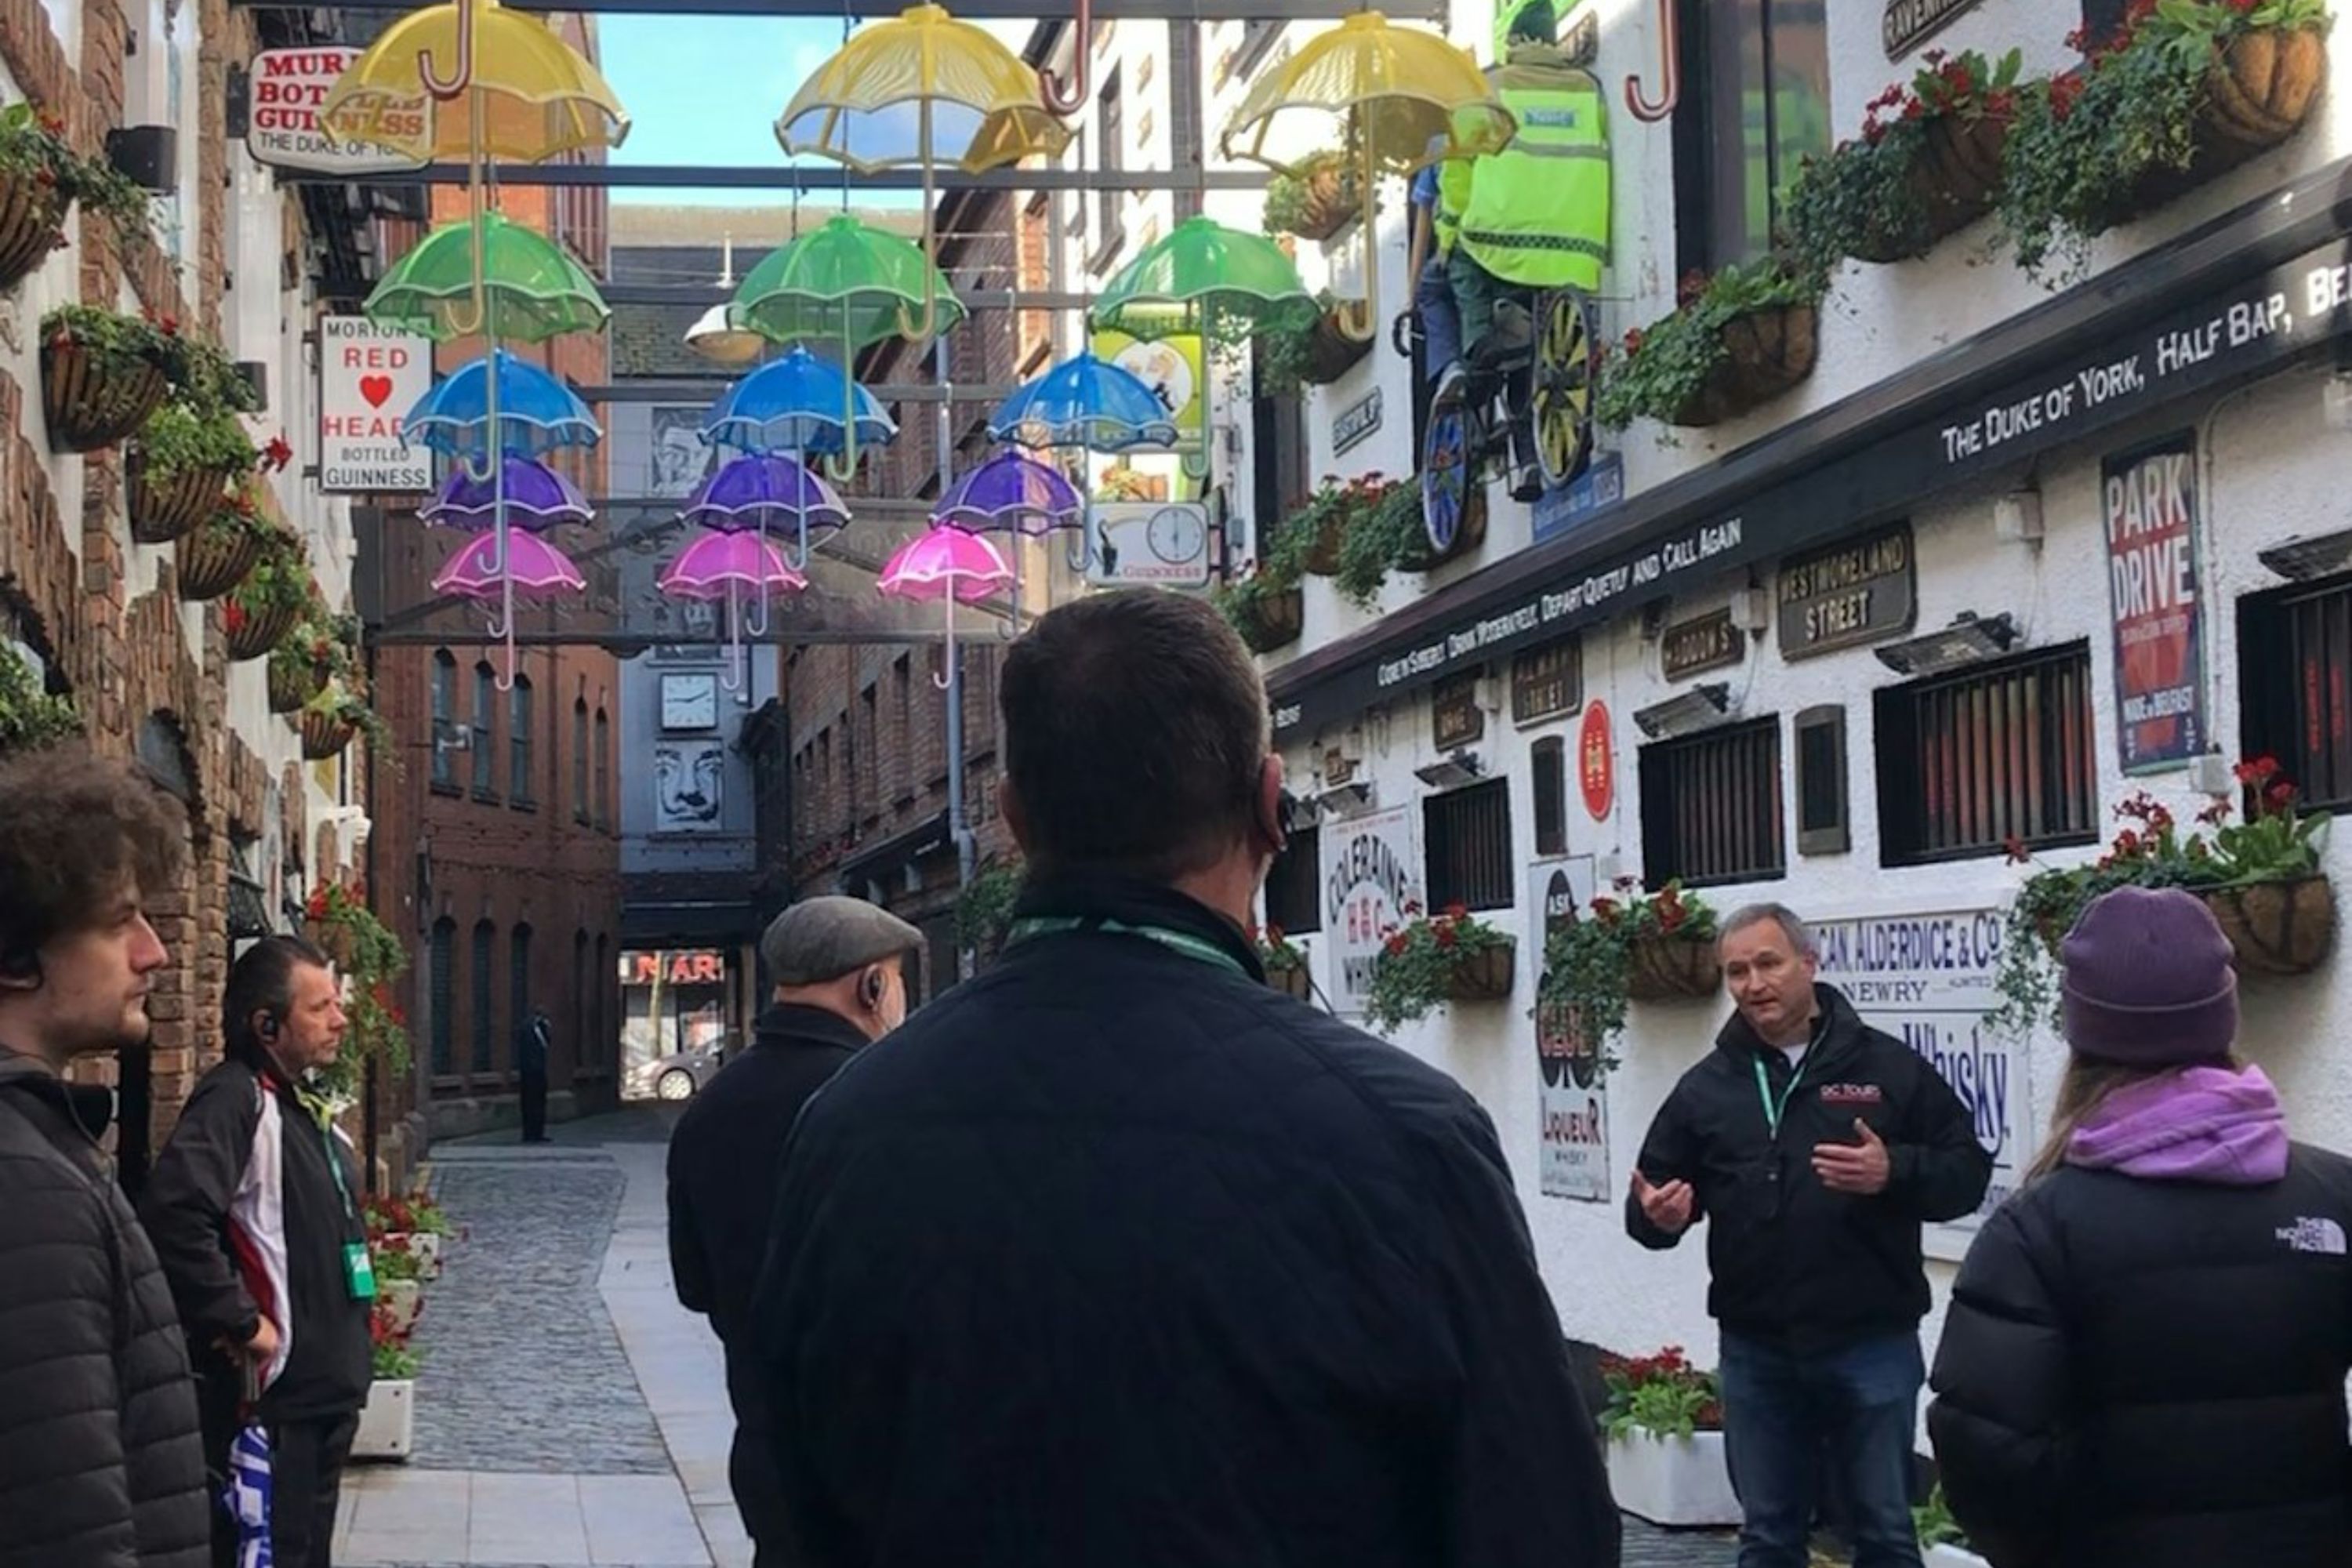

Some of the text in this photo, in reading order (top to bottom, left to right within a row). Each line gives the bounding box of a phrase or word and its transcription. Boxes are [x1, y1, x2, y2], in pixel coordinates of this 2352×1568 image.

[1885, 0, 1952, 46] RAVEN
[263, 53, 358, 77] MUR
[260, 132, 291, 151] THE
[296, 138, 340, 155] DUKE
[347, 141, 367, 155] OF
[343, 347, 408, 368] RED
[1940, 418, 1982, 463] THE
[1985, 394, 2042, 445] DUKE
[2045, 381, 2075, 422] OF
[2078, 354, 2144, 408] YORK,
[2157, 318, 2223, 376] HALF
[2228, 292, 2292, 347] BAP,
[325, 467, 426, 486] GUINNESS
[341, 447, 411, 461] BOTTLED
[2106, 452, 2188, 544] PARK
[1632, 554, 1661, 586] AND
[1662, 539, 1697, 572] CALL
[1698, 517, 1742, 559] AGAIN
[2112, 534, 2194, 625] DRIVE
[1806, 590, 1869, 641] STREET
[1855, 919, 1954, 971] ALDERDICE
[1958, 926, 1971, 969] &
[1840, 981, 1927, 1002] NEWRY
